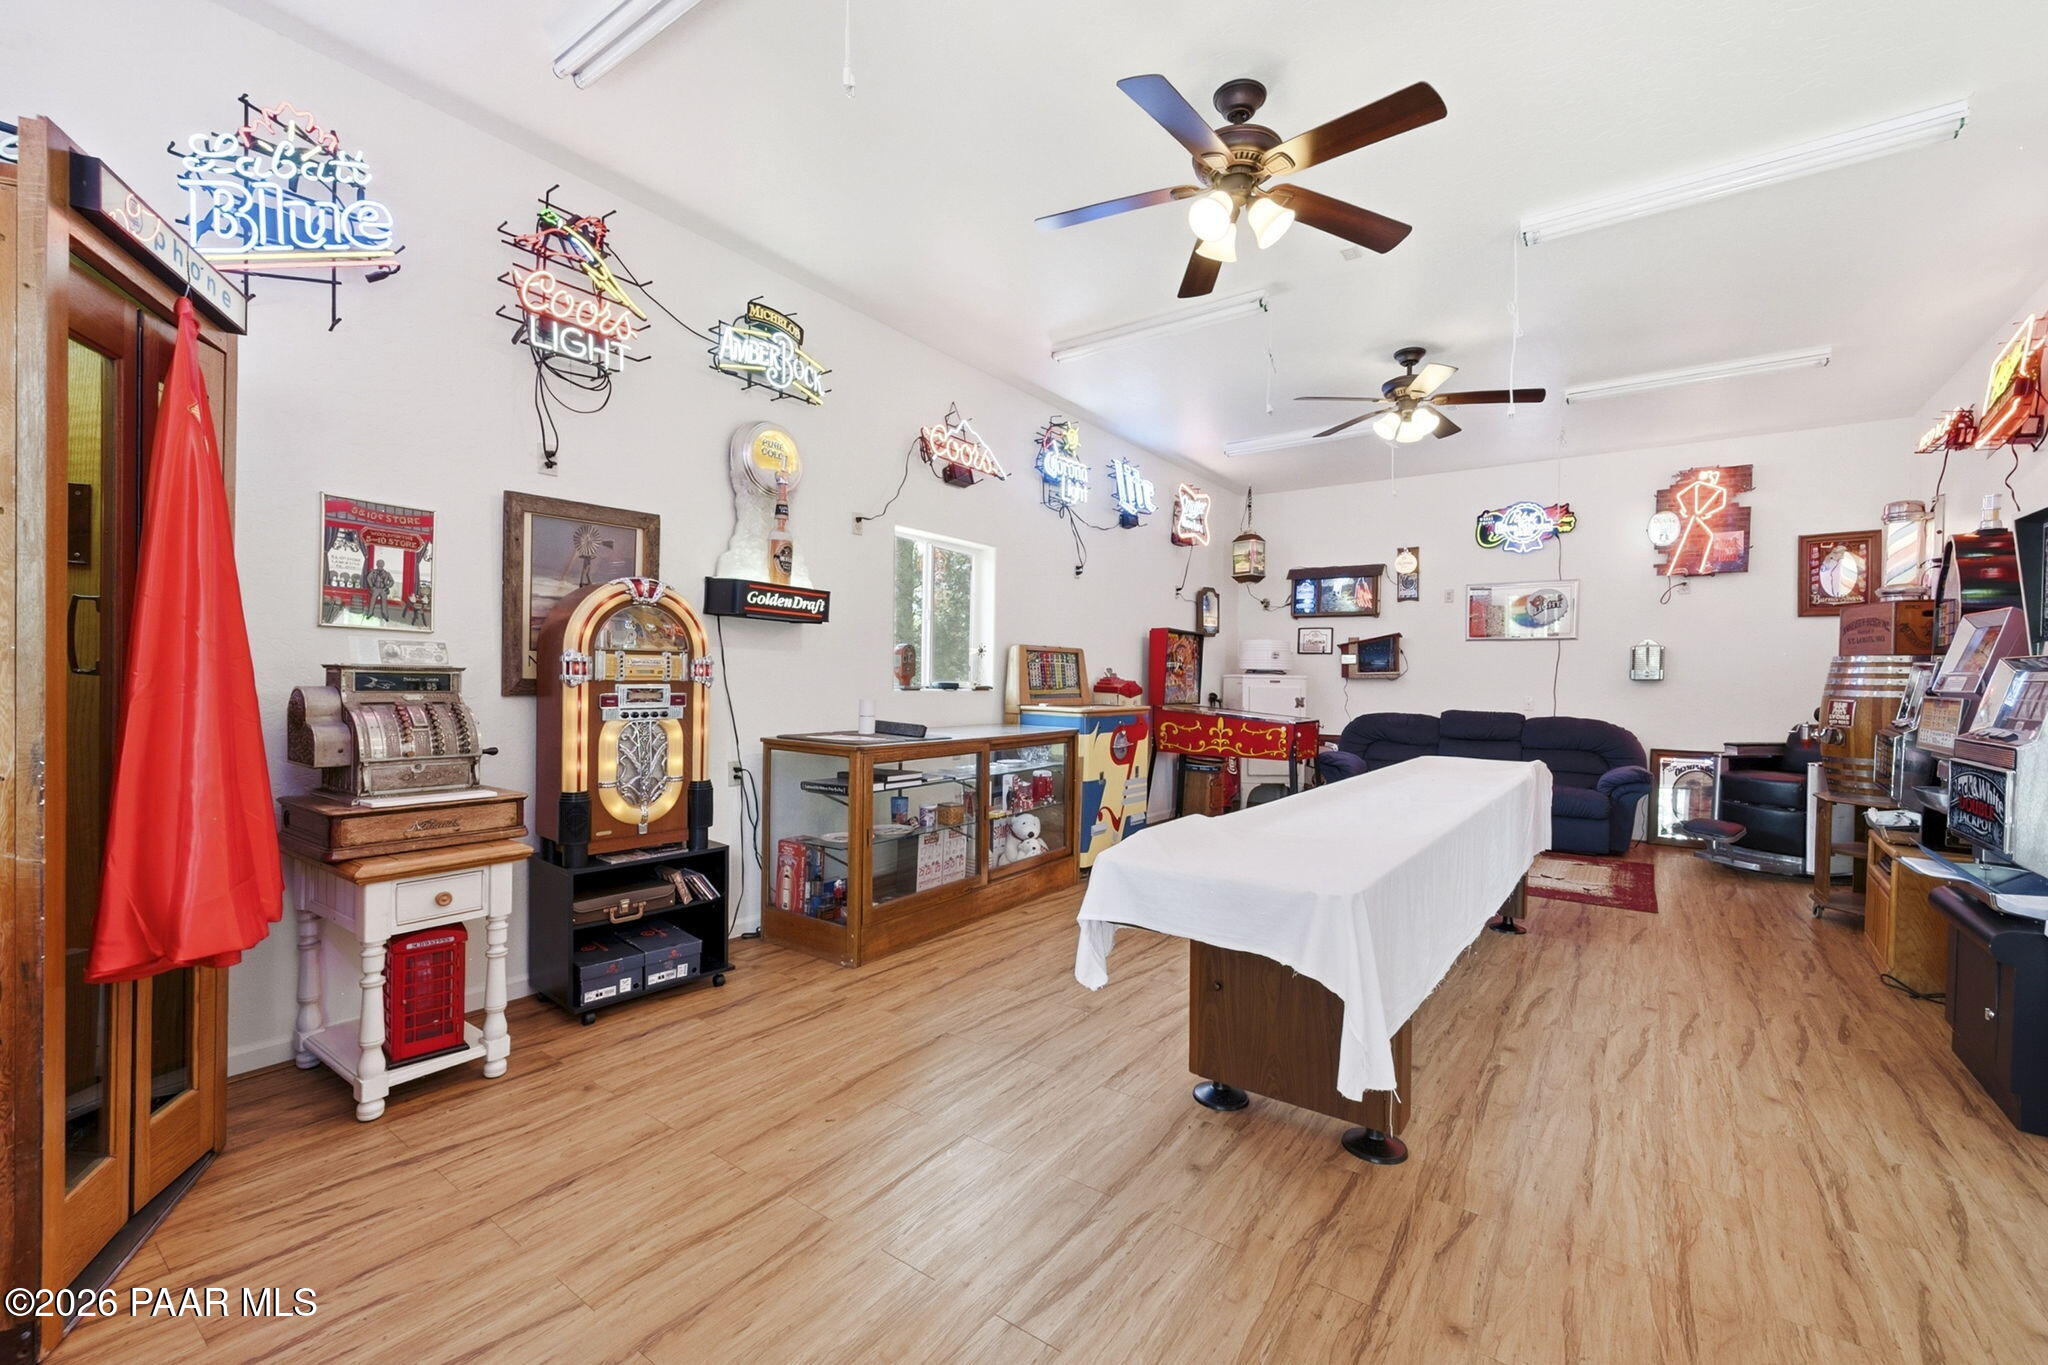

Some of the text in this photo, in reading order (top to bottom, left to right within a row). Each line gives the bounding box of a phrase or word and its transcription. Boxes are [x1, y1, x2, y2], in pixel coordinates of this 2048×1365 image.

[182, 132, 371, 184] Labatt
[176, 178, 393, 252] Blue
[518, 268, 637, 341] Coors
[748, 304, 801, 339] MICHELOB
[529, 315, 633, 373] LIGHT
[924, 425, 998, 473] Coors
[1044, 452, 1088, 482] Corona
[386, 514, 421, 525] STORE
[388, 537, 418, 549] STORE
[1958, 810, 1992, 833] JACKPOT
